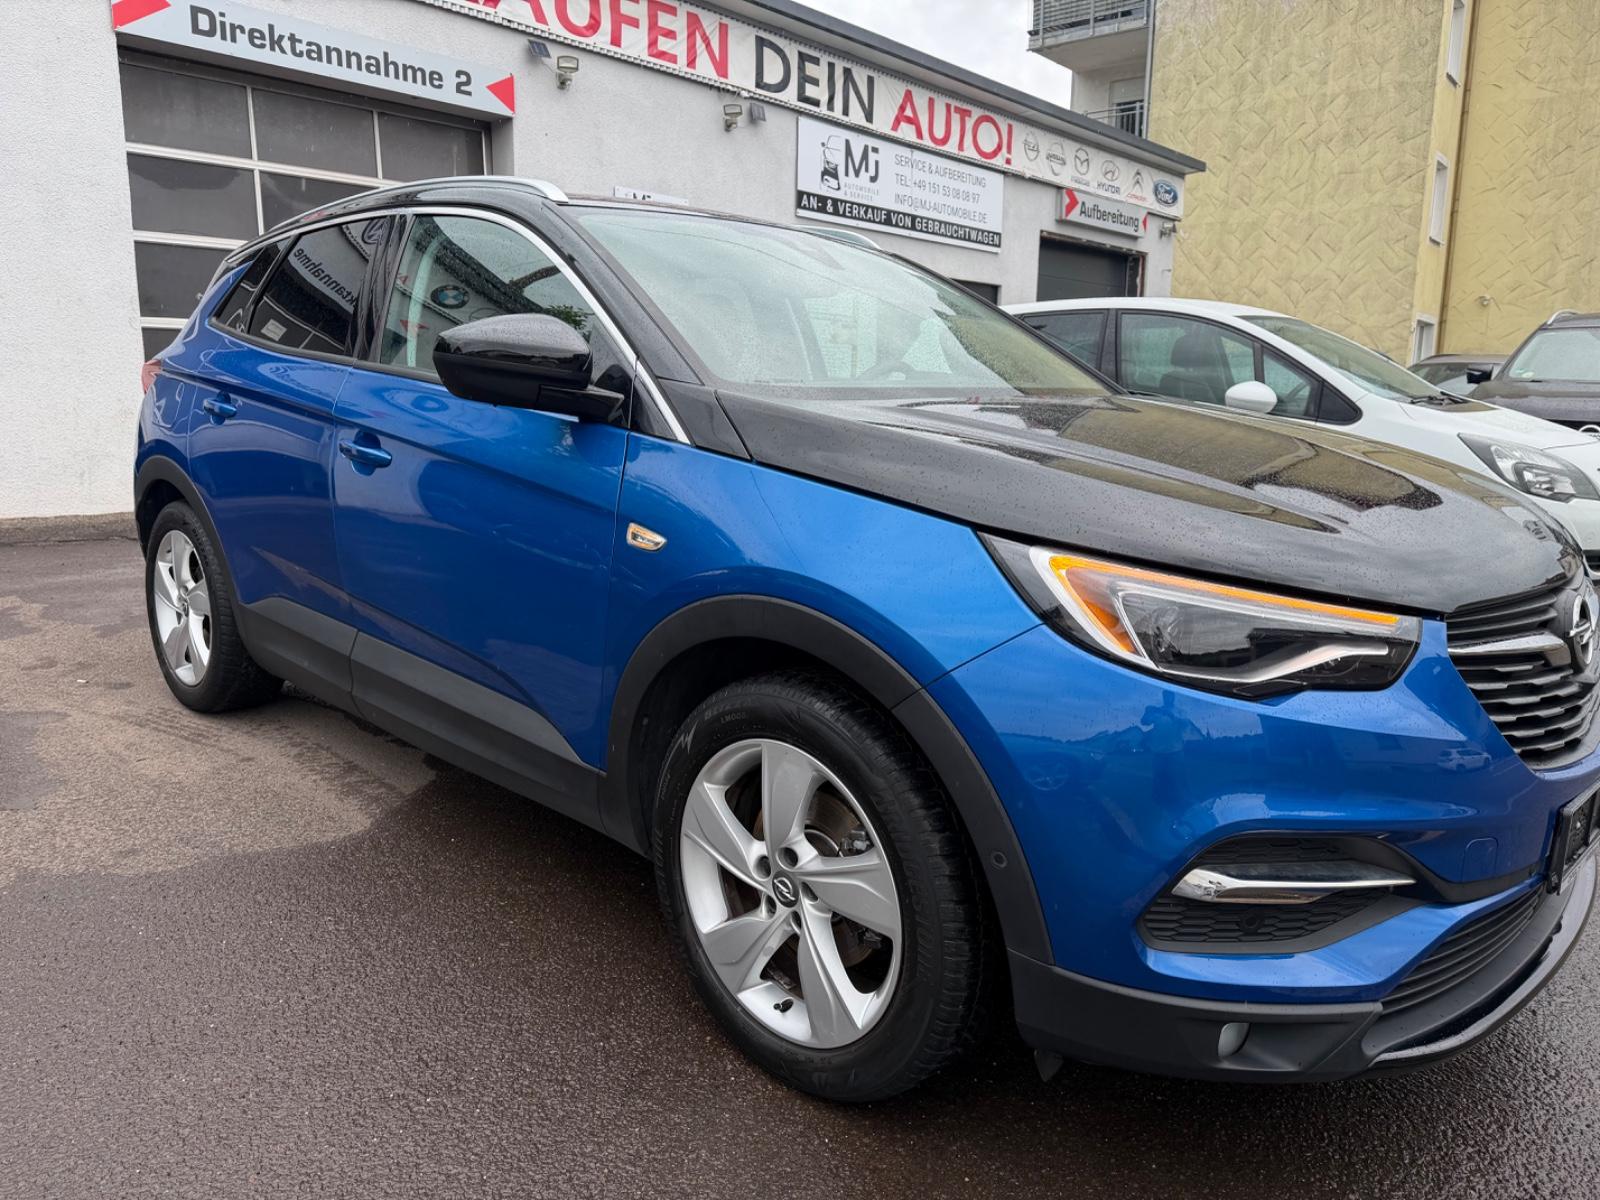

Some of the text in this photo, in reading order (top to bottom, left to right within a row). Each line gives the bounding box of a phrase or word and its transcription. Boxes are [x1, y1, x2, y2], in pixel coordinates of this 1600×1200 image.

[189, 4, 473, 96] Direktannahme 2
[755, 35, 875, 125] DEIN
[891, 88, 1013, 165] AUTO!
[894, 154, 926, 173] SERVICE
[935, 166, 987, 188] AUFBEREITUNG
[894, 193, 988, 224] INFO@MJ-AUTOMOBILE.DE
[913, 179, 927, 191] +49
[928, 182, 940, 194] 151
[942, 185, 951, 197] 53
[952, 188, 960, 200] 08
[962, 190, 970, 202] 08
[972, 192, 980, 204] 97
[801, 194, 1000, 246] AN- & VERKAUF VON GEBRAUCHTWAGEN
[1079, 201, 1140, 232] Aufbereitung
